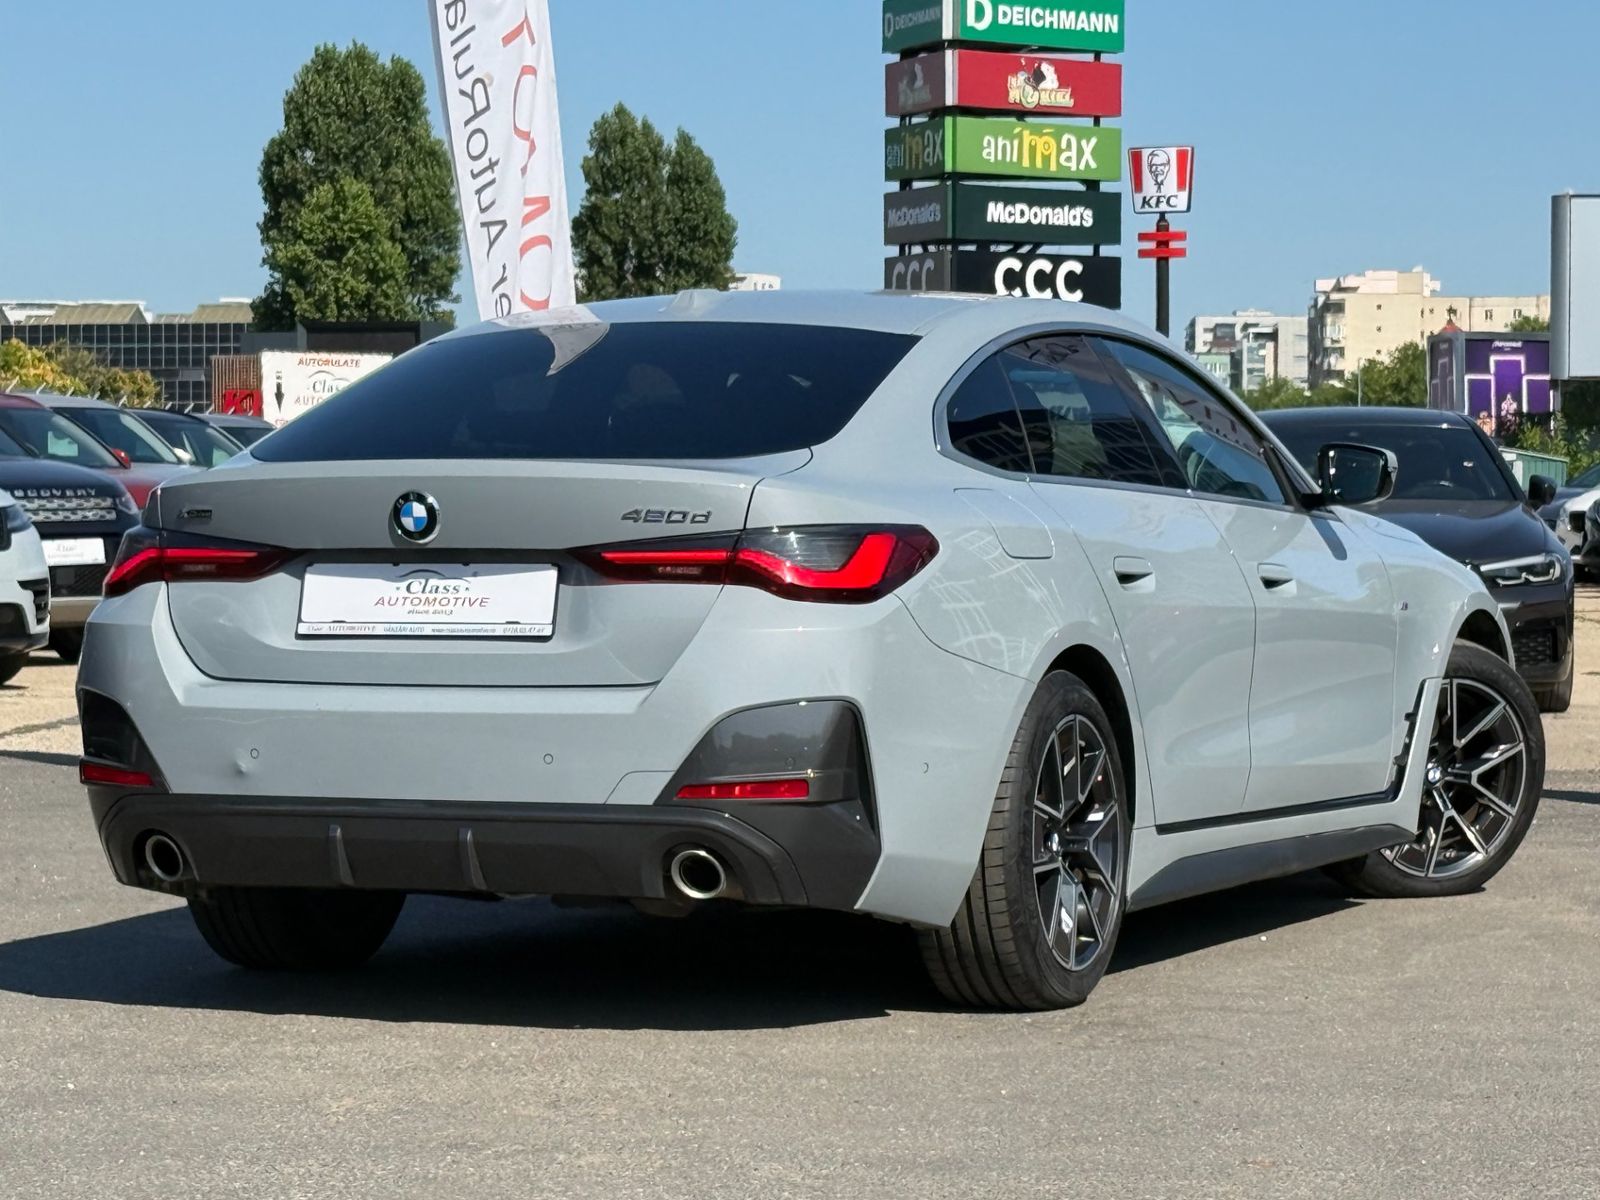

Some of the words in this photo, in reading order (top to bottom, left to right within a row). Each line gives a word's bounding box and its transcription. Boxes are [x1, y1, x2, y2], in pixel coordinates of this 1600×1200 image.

[895, 5, 941, 30] DEICHMANN
[997, 4, 1120, 33] DEICHMANN
[886, 127, 944, 170] animax
[982, 126, 1099, 172] animax
[1140, 194, 1178, 209] KFC
[887, 203, 942, 228] McDonald's
[986, 201, 1095, 228] McDonald's
[994, 257, 1085, 302] CCC
[312, 379, 345, 394] Clas
[13, 488, 96, 497] SCOVERY
[620, 508, 713, 524] 420d
[405, 579, 462, 595] Class
[374, 596, 491, 608] AUTOMOTIVE
